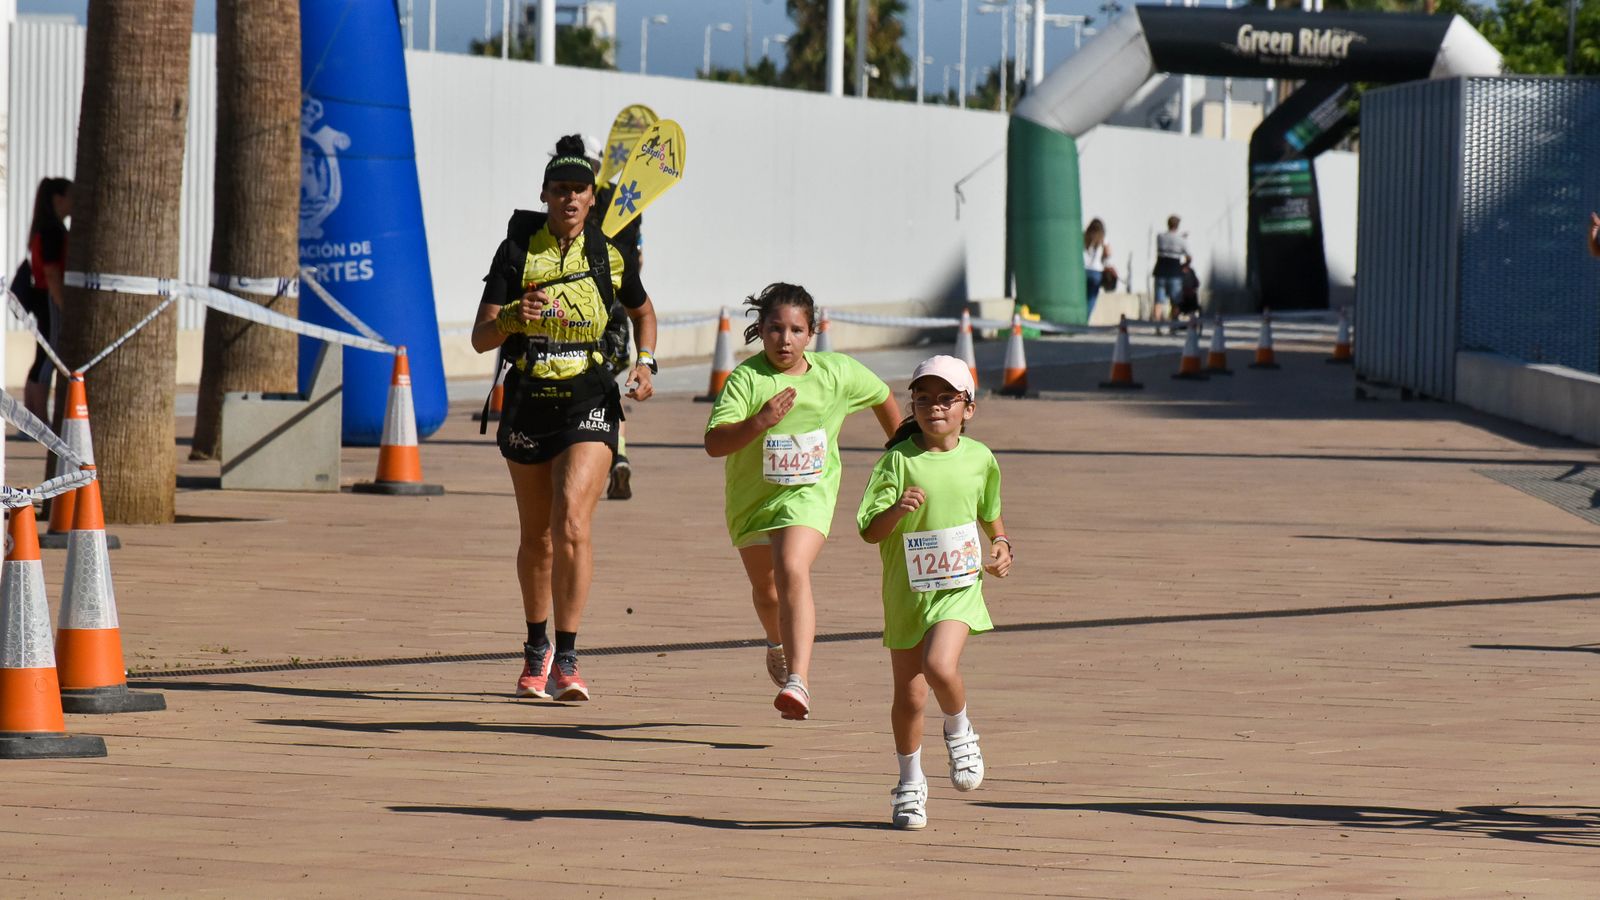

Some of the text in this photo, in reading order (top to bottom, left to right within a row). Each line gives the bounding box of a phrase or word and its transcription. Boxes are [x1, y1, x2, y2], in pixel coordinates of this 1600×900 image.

[1237, 23, 1294, 56] Green
[1298, 27, 1353, 59] Rider
[658, 162, 679, 179] Sport
[299, 240, 372, 258] ACIÓN DE
[561, 318, 592, 329] Sport
[577, 420, 611, 433] ABADES
[766, 439, 779, 448] XXI
[768, 452, 811, 472] 1442
[907, 537, 922, 548] XXI
[912, 549, 964, 576] 1242
